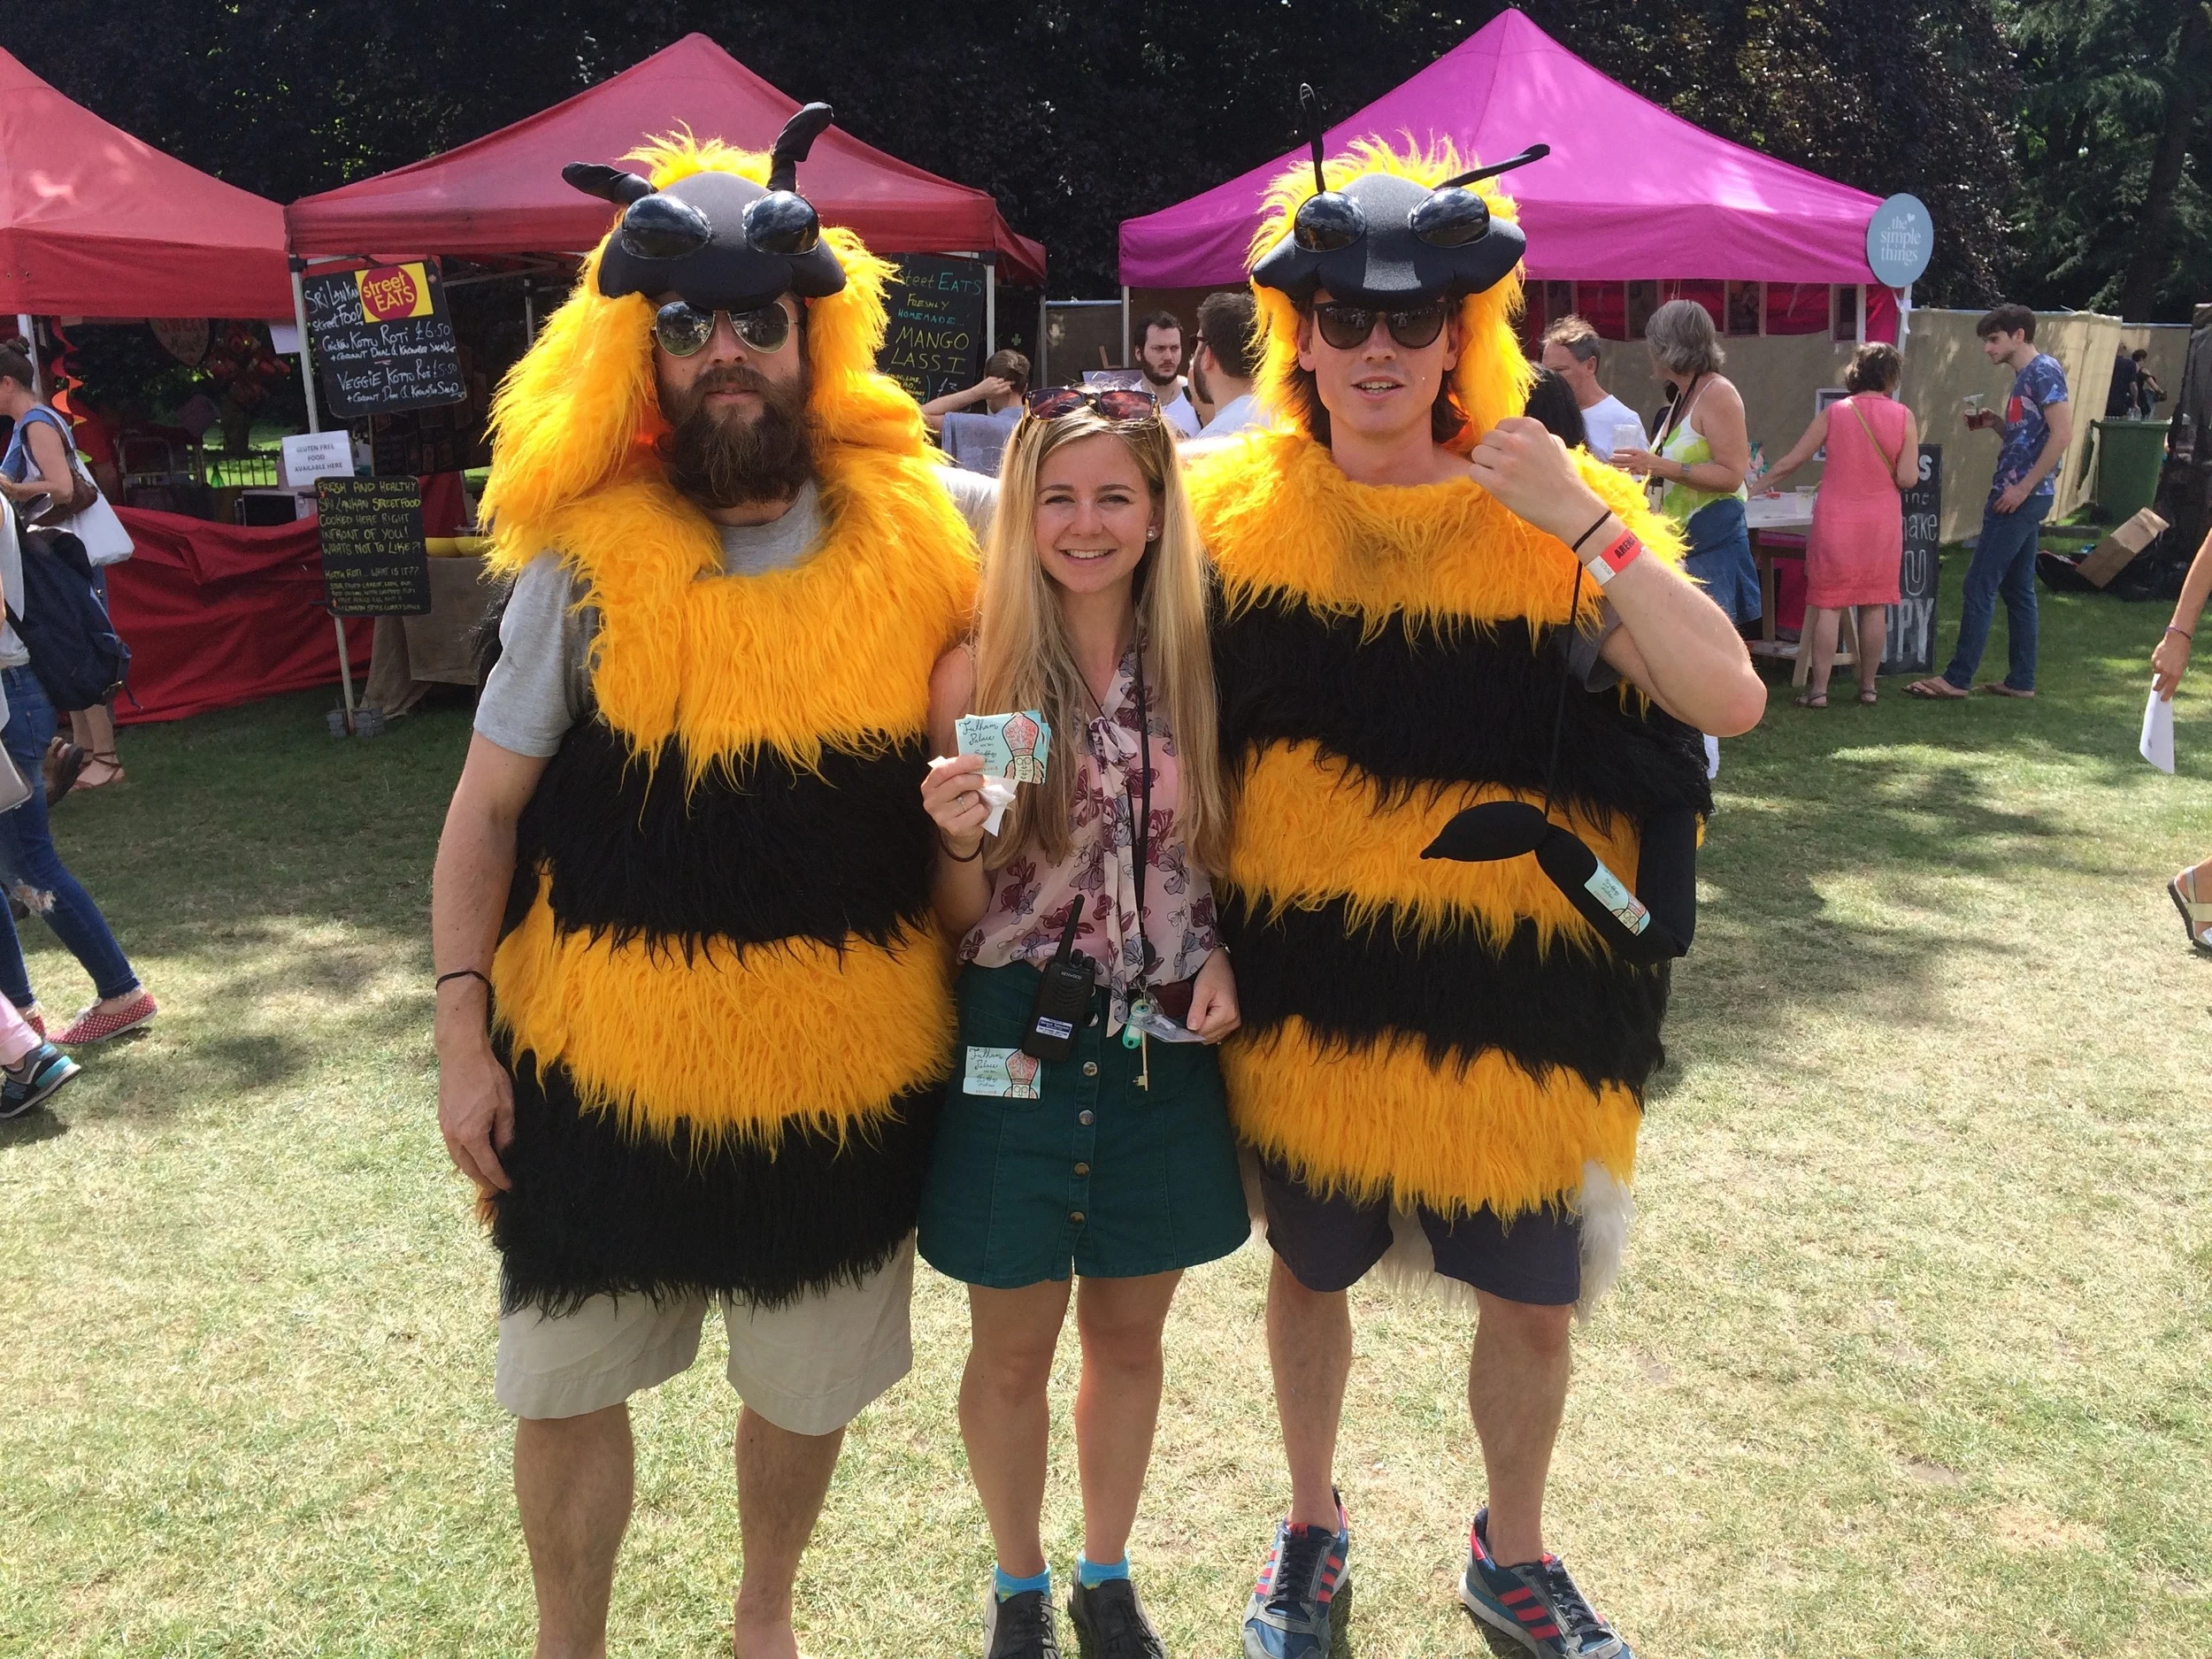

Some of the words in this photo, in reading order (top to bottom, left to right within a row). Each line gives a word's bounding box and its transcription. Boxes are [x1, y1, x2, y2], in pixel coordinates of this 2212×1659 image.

[1892, 216, 1908, 229] the
[1880, 227, 1922, 249] simple
[1881, 243, 1918, 266] things
[364, 272, 406, 299] street
[938, 272, 982, 296] EATS
[374, 285, 415, 312] EATS
[907, 293, 949, 311] FRESHLY
[336, 302, 363, 326] FOOD
[349, 331, 378, 350] KOTTU
[415, 320, 450, 342] £6.50
[895, 326, 970, 350] MANGO
[891, 347, 965, 375] LASSI
[386, 367, 415, 386] KOTTU
[296, 444, 319, 453] GLUTEN
[295, 464, 326, 472] AVAILABLE
[318, 481, 347, 494] FRESH
[353, 482, 375, 493] AND
[380, 480, 417, 493] HEALTHY
[334, 497, 369, 512] LANKAN
[319, 514, 353, 527] COOKED
[356, 515, 377, 524] HERE
[381, 513, 410, 524] RIGHT
[363, 528, 376, 540] OF
[381, 526, 410, 541] YOU!
[322, 542, 353, 556] WHATS
[354, 543, 372, 554] NOT
[374, 542, 385, 553] TO
[1881, 597, 1935, 664] PPY
[959, 719, 999, 735] Fulham
[969, 733, 995, 746] Palace
[1061, 971, 1083, 980] KENWOOD
[969, 1048, 1003, 1060] Fulham
[974, 1059, 999, 1071] Palace
